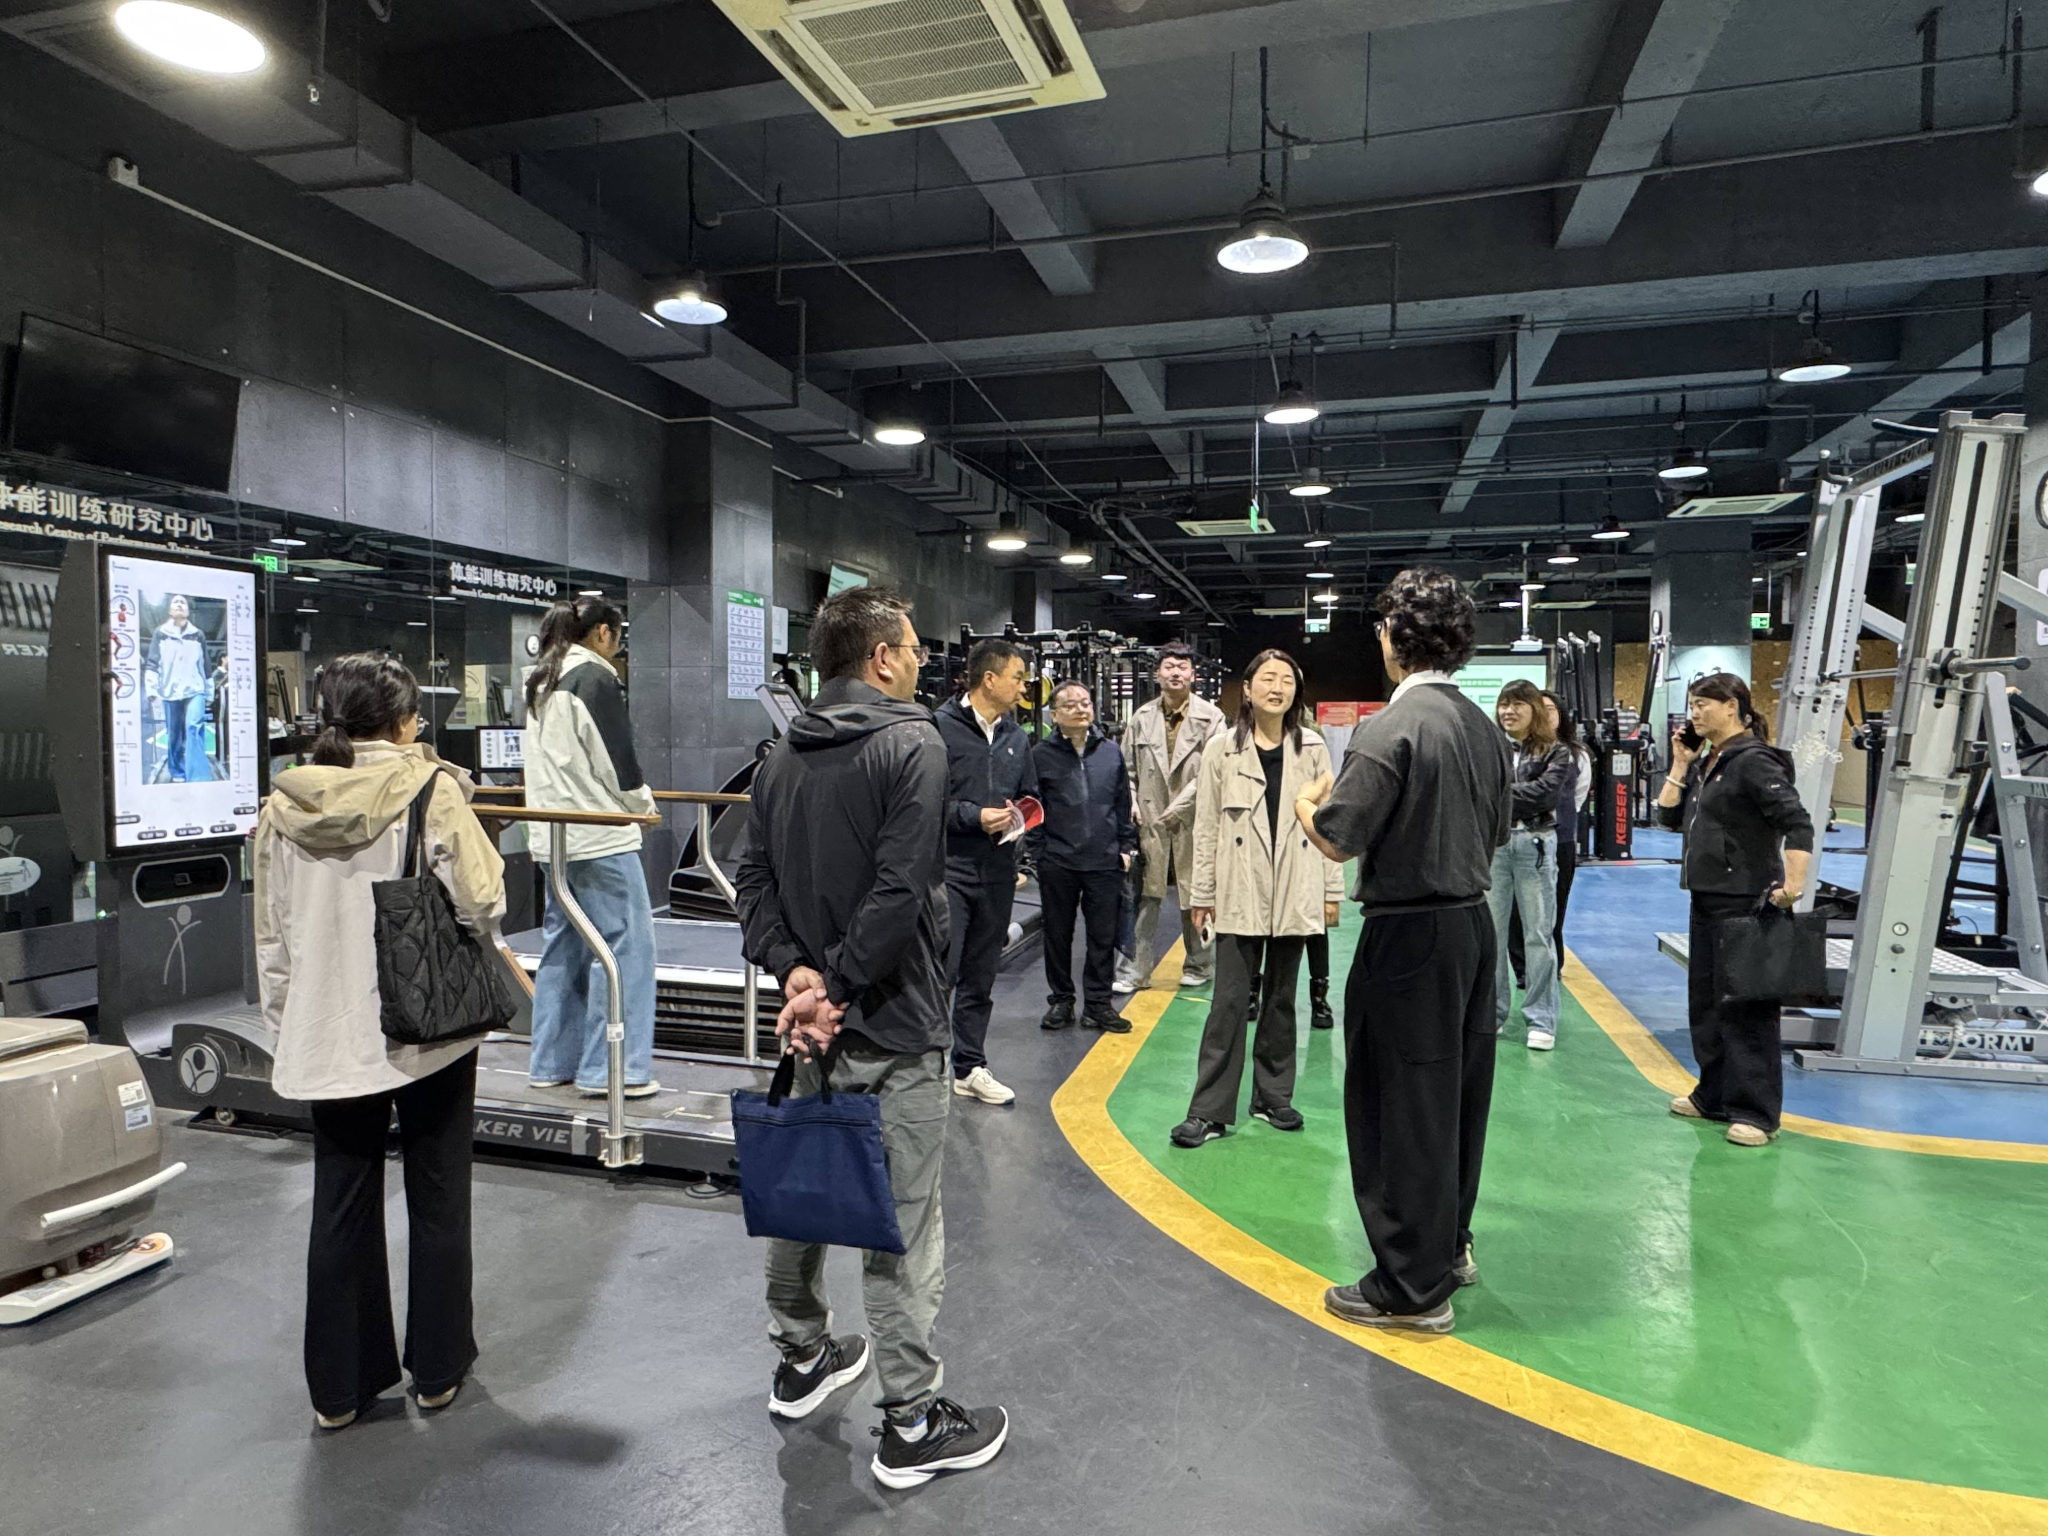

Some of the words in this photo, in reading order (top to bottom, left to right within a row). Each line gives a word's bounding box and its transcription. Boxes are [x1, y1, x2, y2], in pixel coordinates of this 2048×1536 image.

[44, 524, 85, 541] Centre
[86, 531, 98, 541] of
[450, 562, 557, 596] 体能训练研究中心
[1616, 782, 1627, 846] KEISER
[474, 1119, 523, 1138] KER
